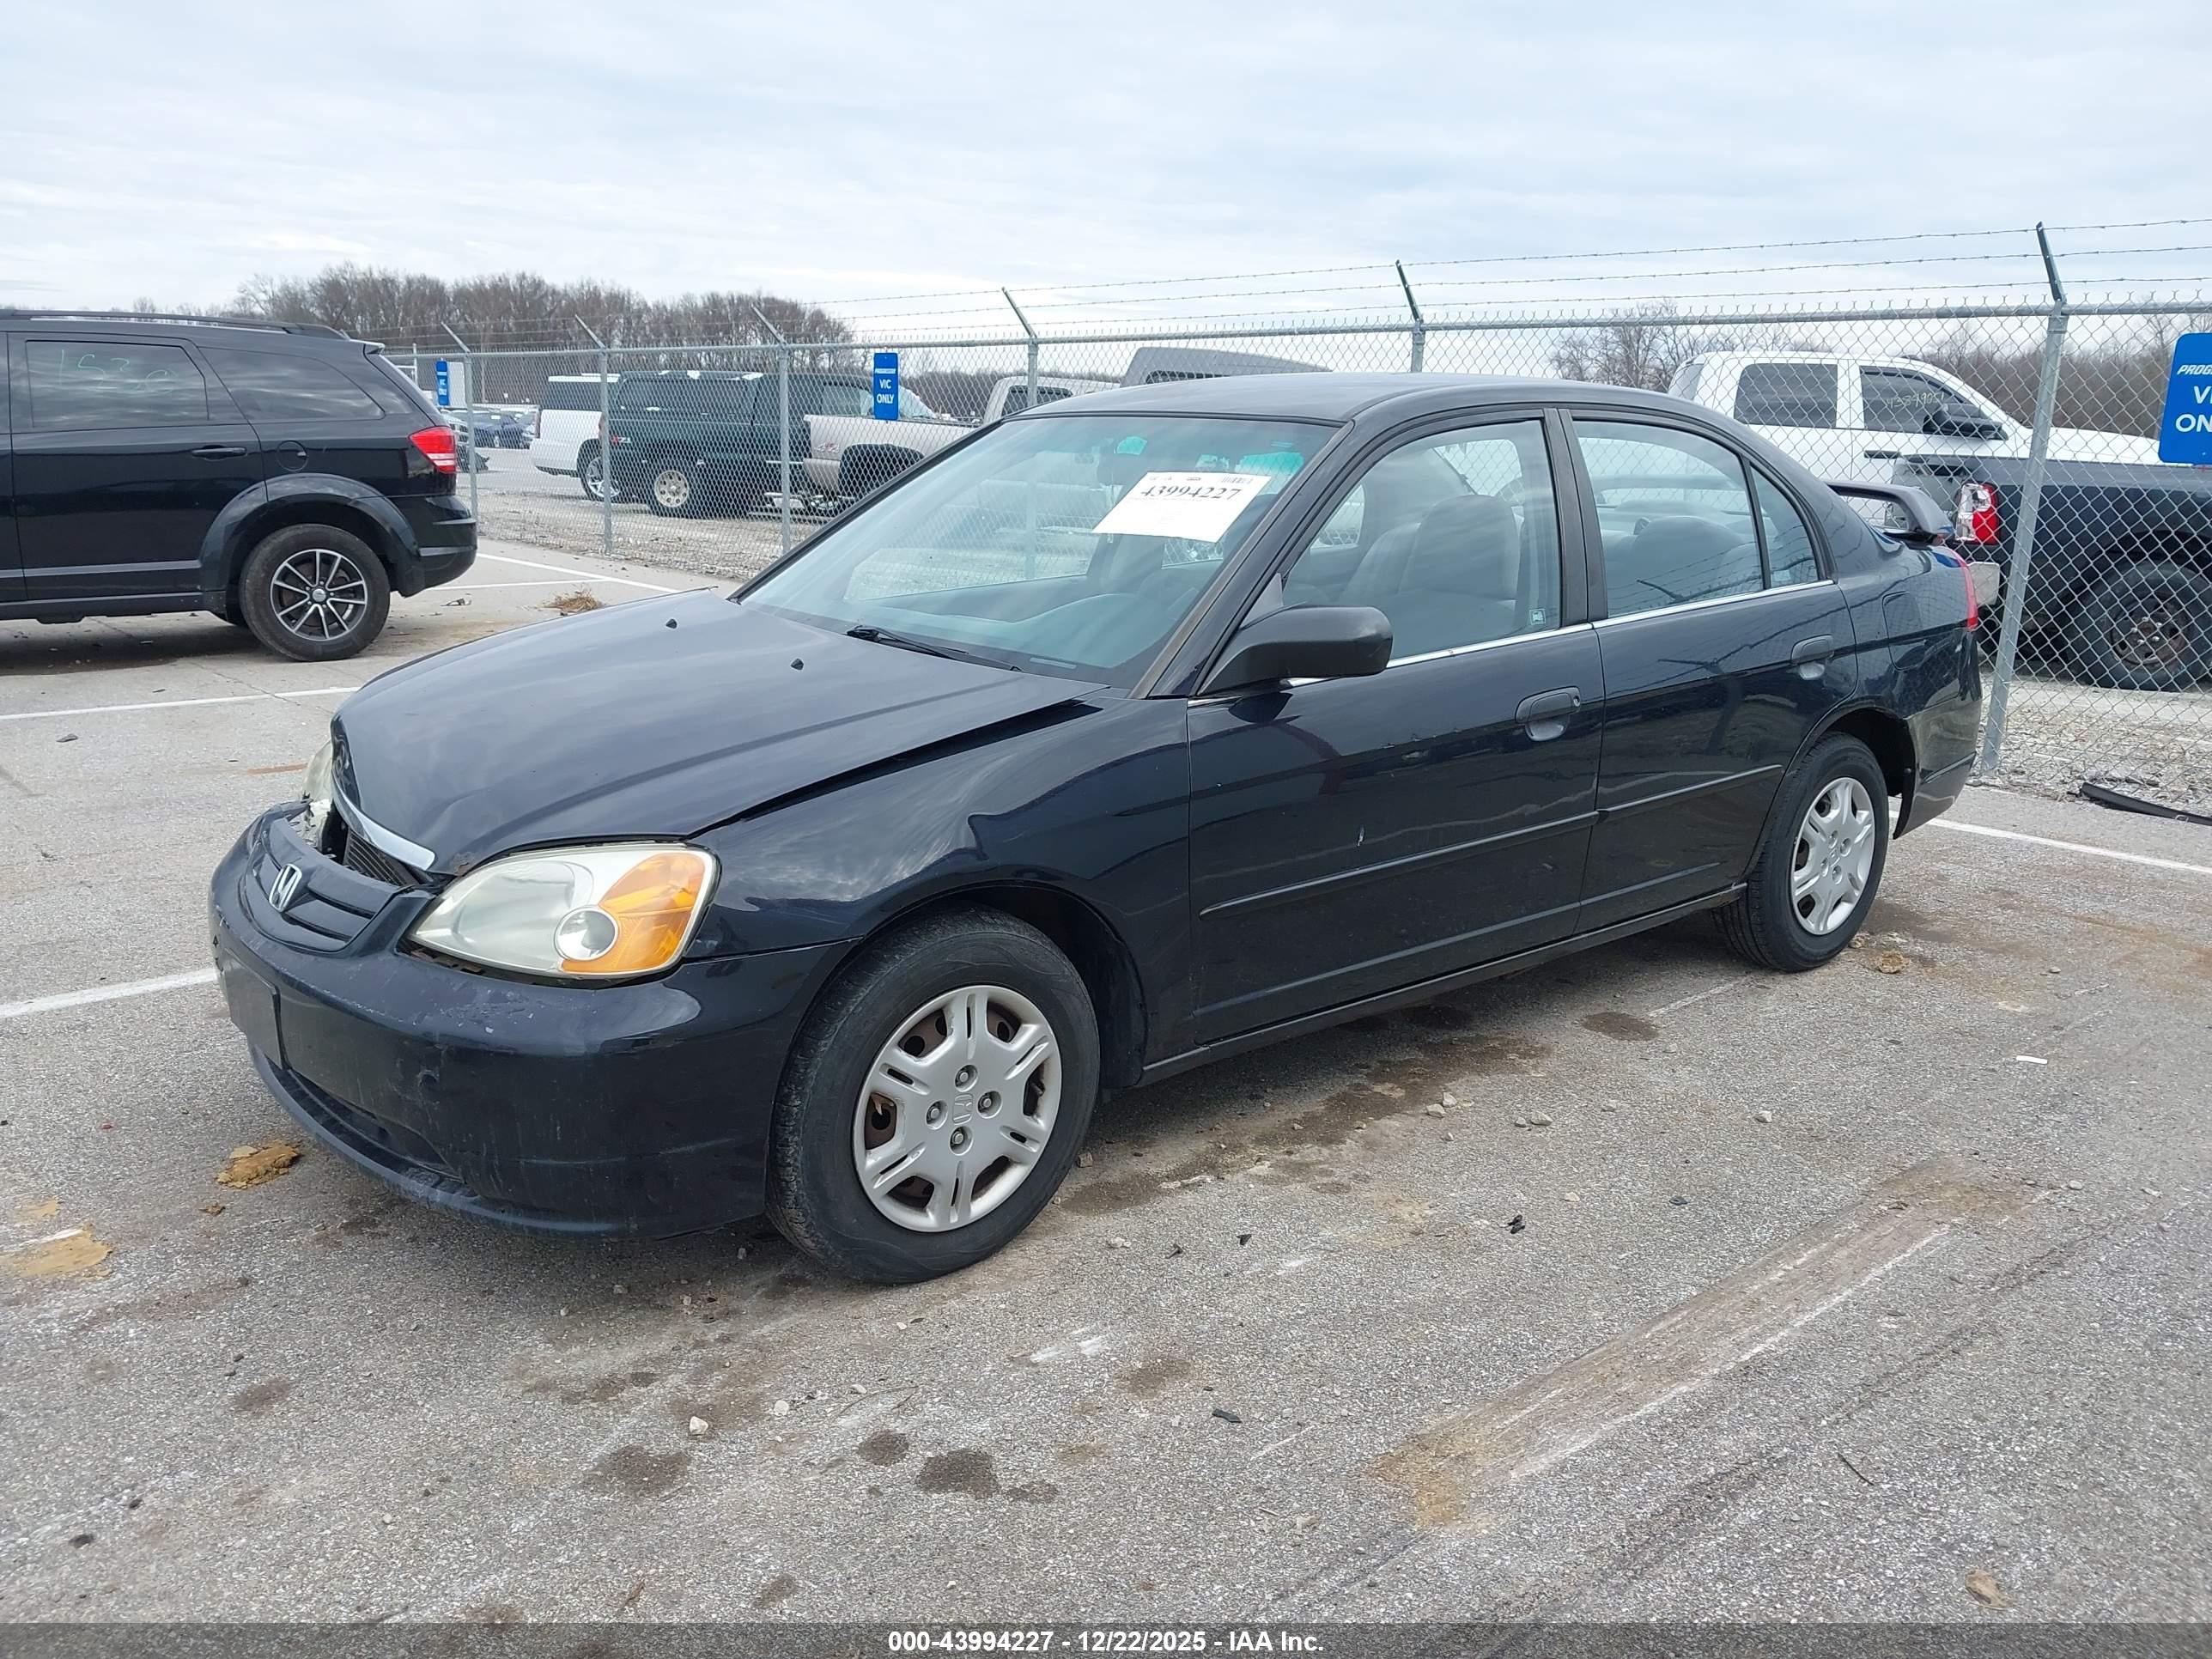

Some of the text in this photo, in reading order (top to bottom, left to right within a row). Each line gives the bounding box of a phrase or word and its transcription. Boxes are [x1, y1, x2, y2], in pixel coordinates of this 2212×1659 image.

[879, 379, 892, 389] VIC
[876, 393, 895, 404] ONLY
[1140, 484, 1243, 501] 43994227
